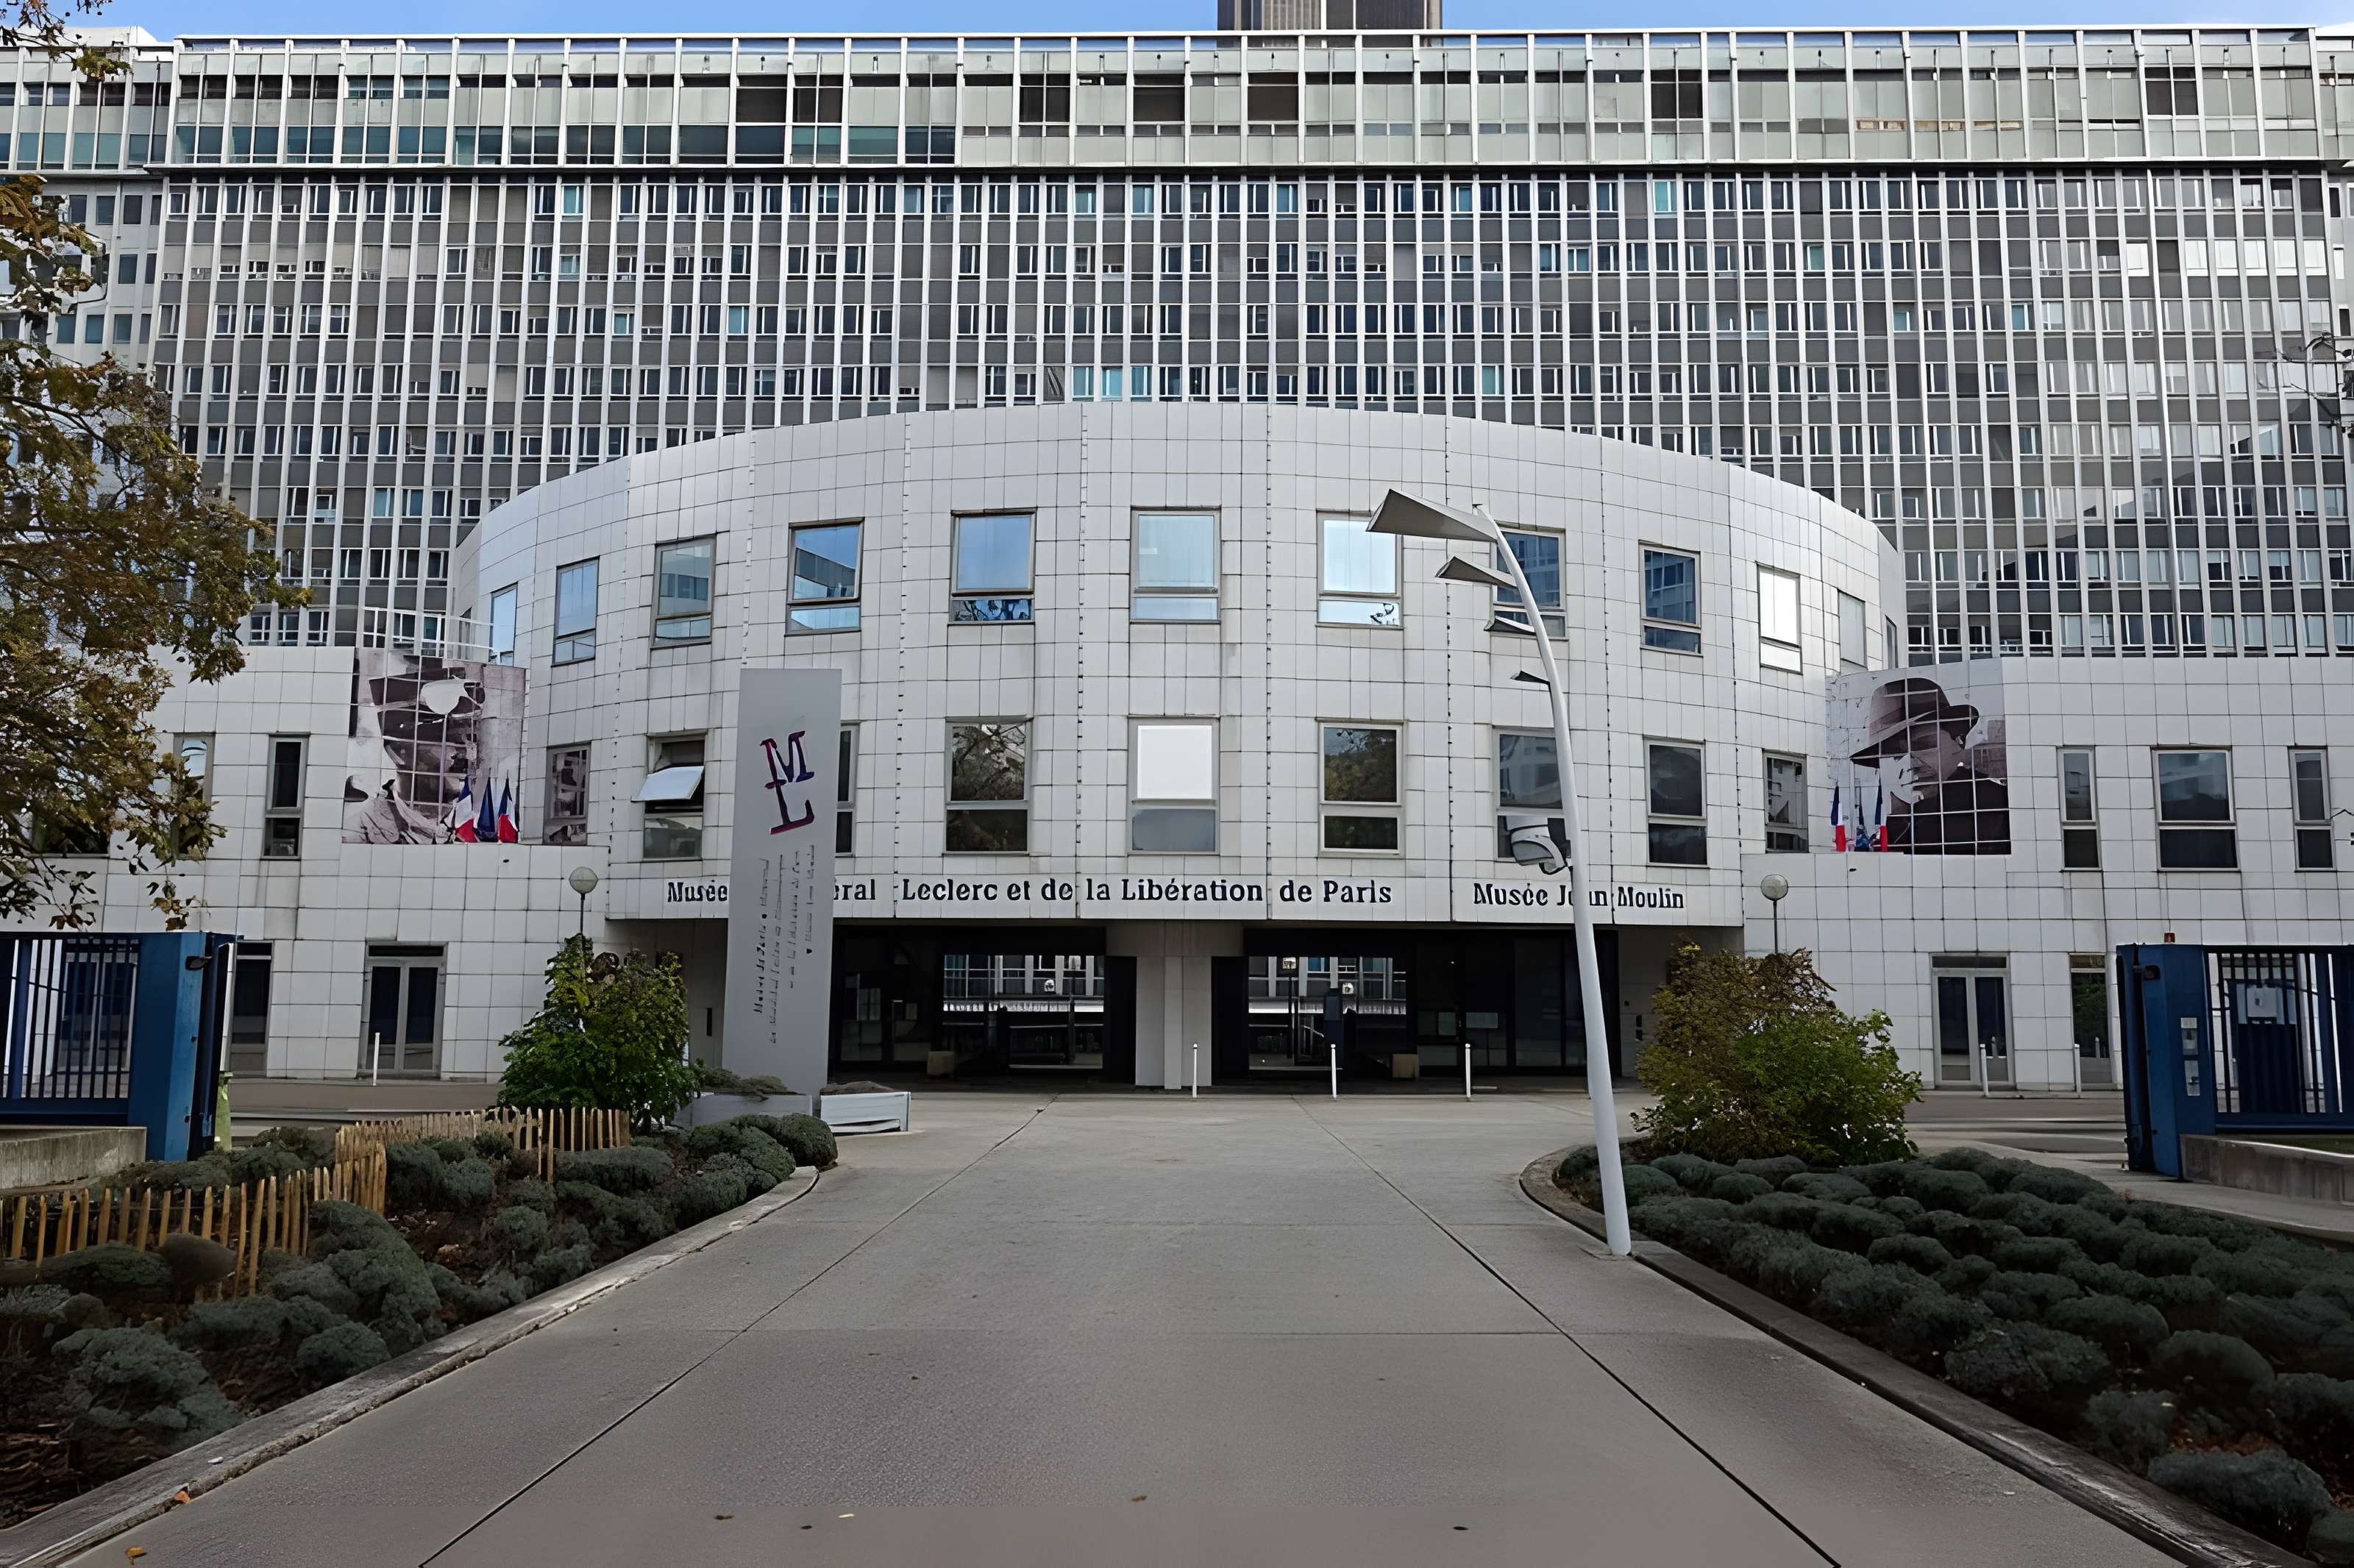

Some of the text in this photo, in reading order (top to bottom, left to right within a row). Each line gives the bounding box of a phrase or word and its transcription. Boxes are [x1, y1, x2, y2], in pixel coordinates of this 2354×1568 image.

[667, 880, 728, 902] Musée
[902, 879, 998, 902] Leclerc
[1006, 880, 1031, 901] et
[1041, 877, 1073, 902] de
[1086, 878, 1111, 901] la
[1121, 877, 1263, 902] Libération
[1279, 880, 1312, 902] de
[1323, 880, 1392, 903] Paris
[1473, 883, 1684, 908] Musée Jn Moulin
